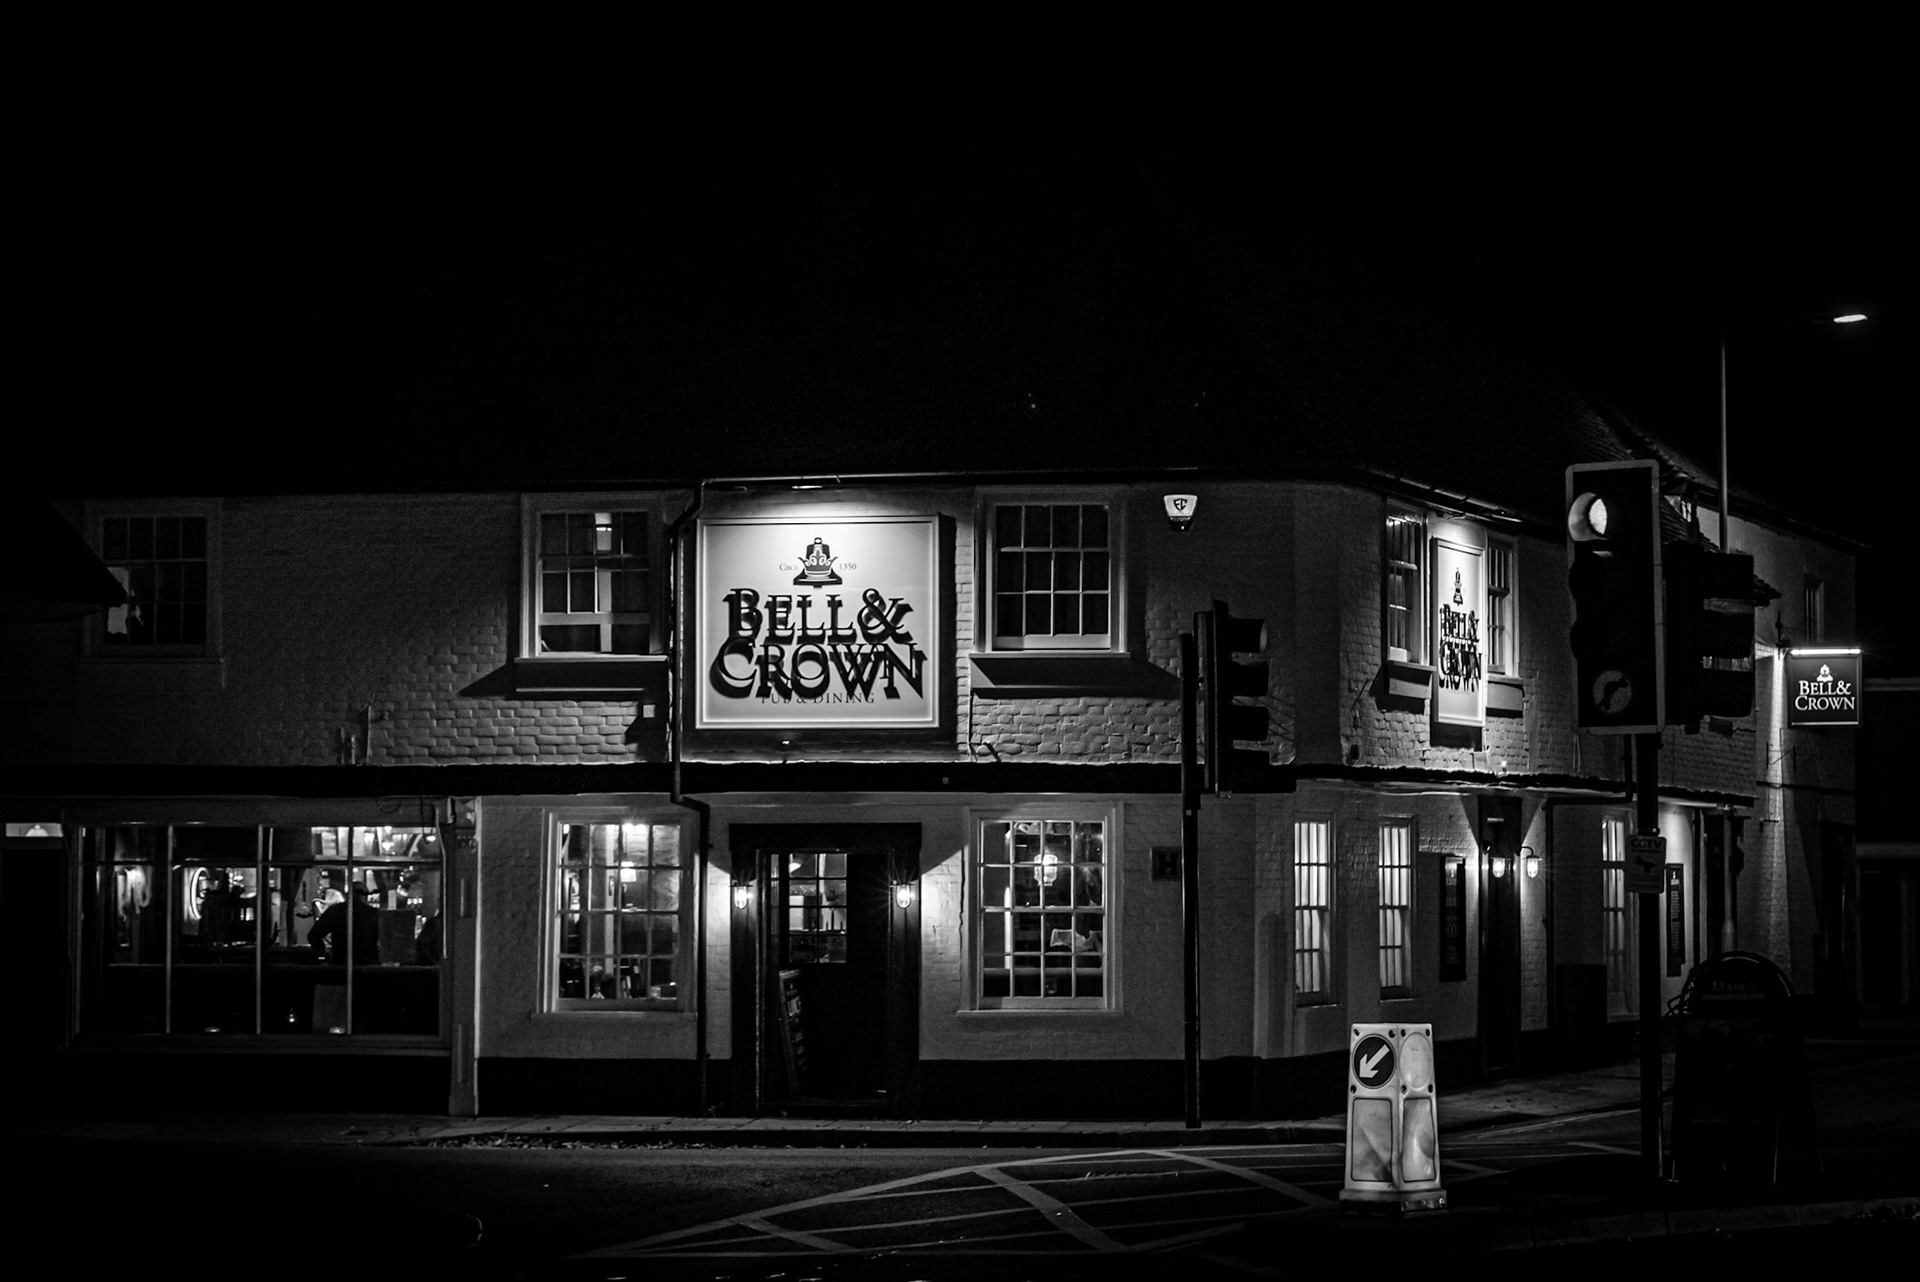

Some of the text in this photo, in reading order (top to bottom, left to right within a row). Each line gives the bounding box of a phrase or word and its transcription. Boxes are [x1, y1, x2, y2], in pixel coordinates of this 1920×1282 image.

[839, 562, 857, 571] 1350
[714, 637, 921, 685] CROWN
[1794, 695, 1856, 711] CROWN
[1630, 838, 1662, 849] CCTV
